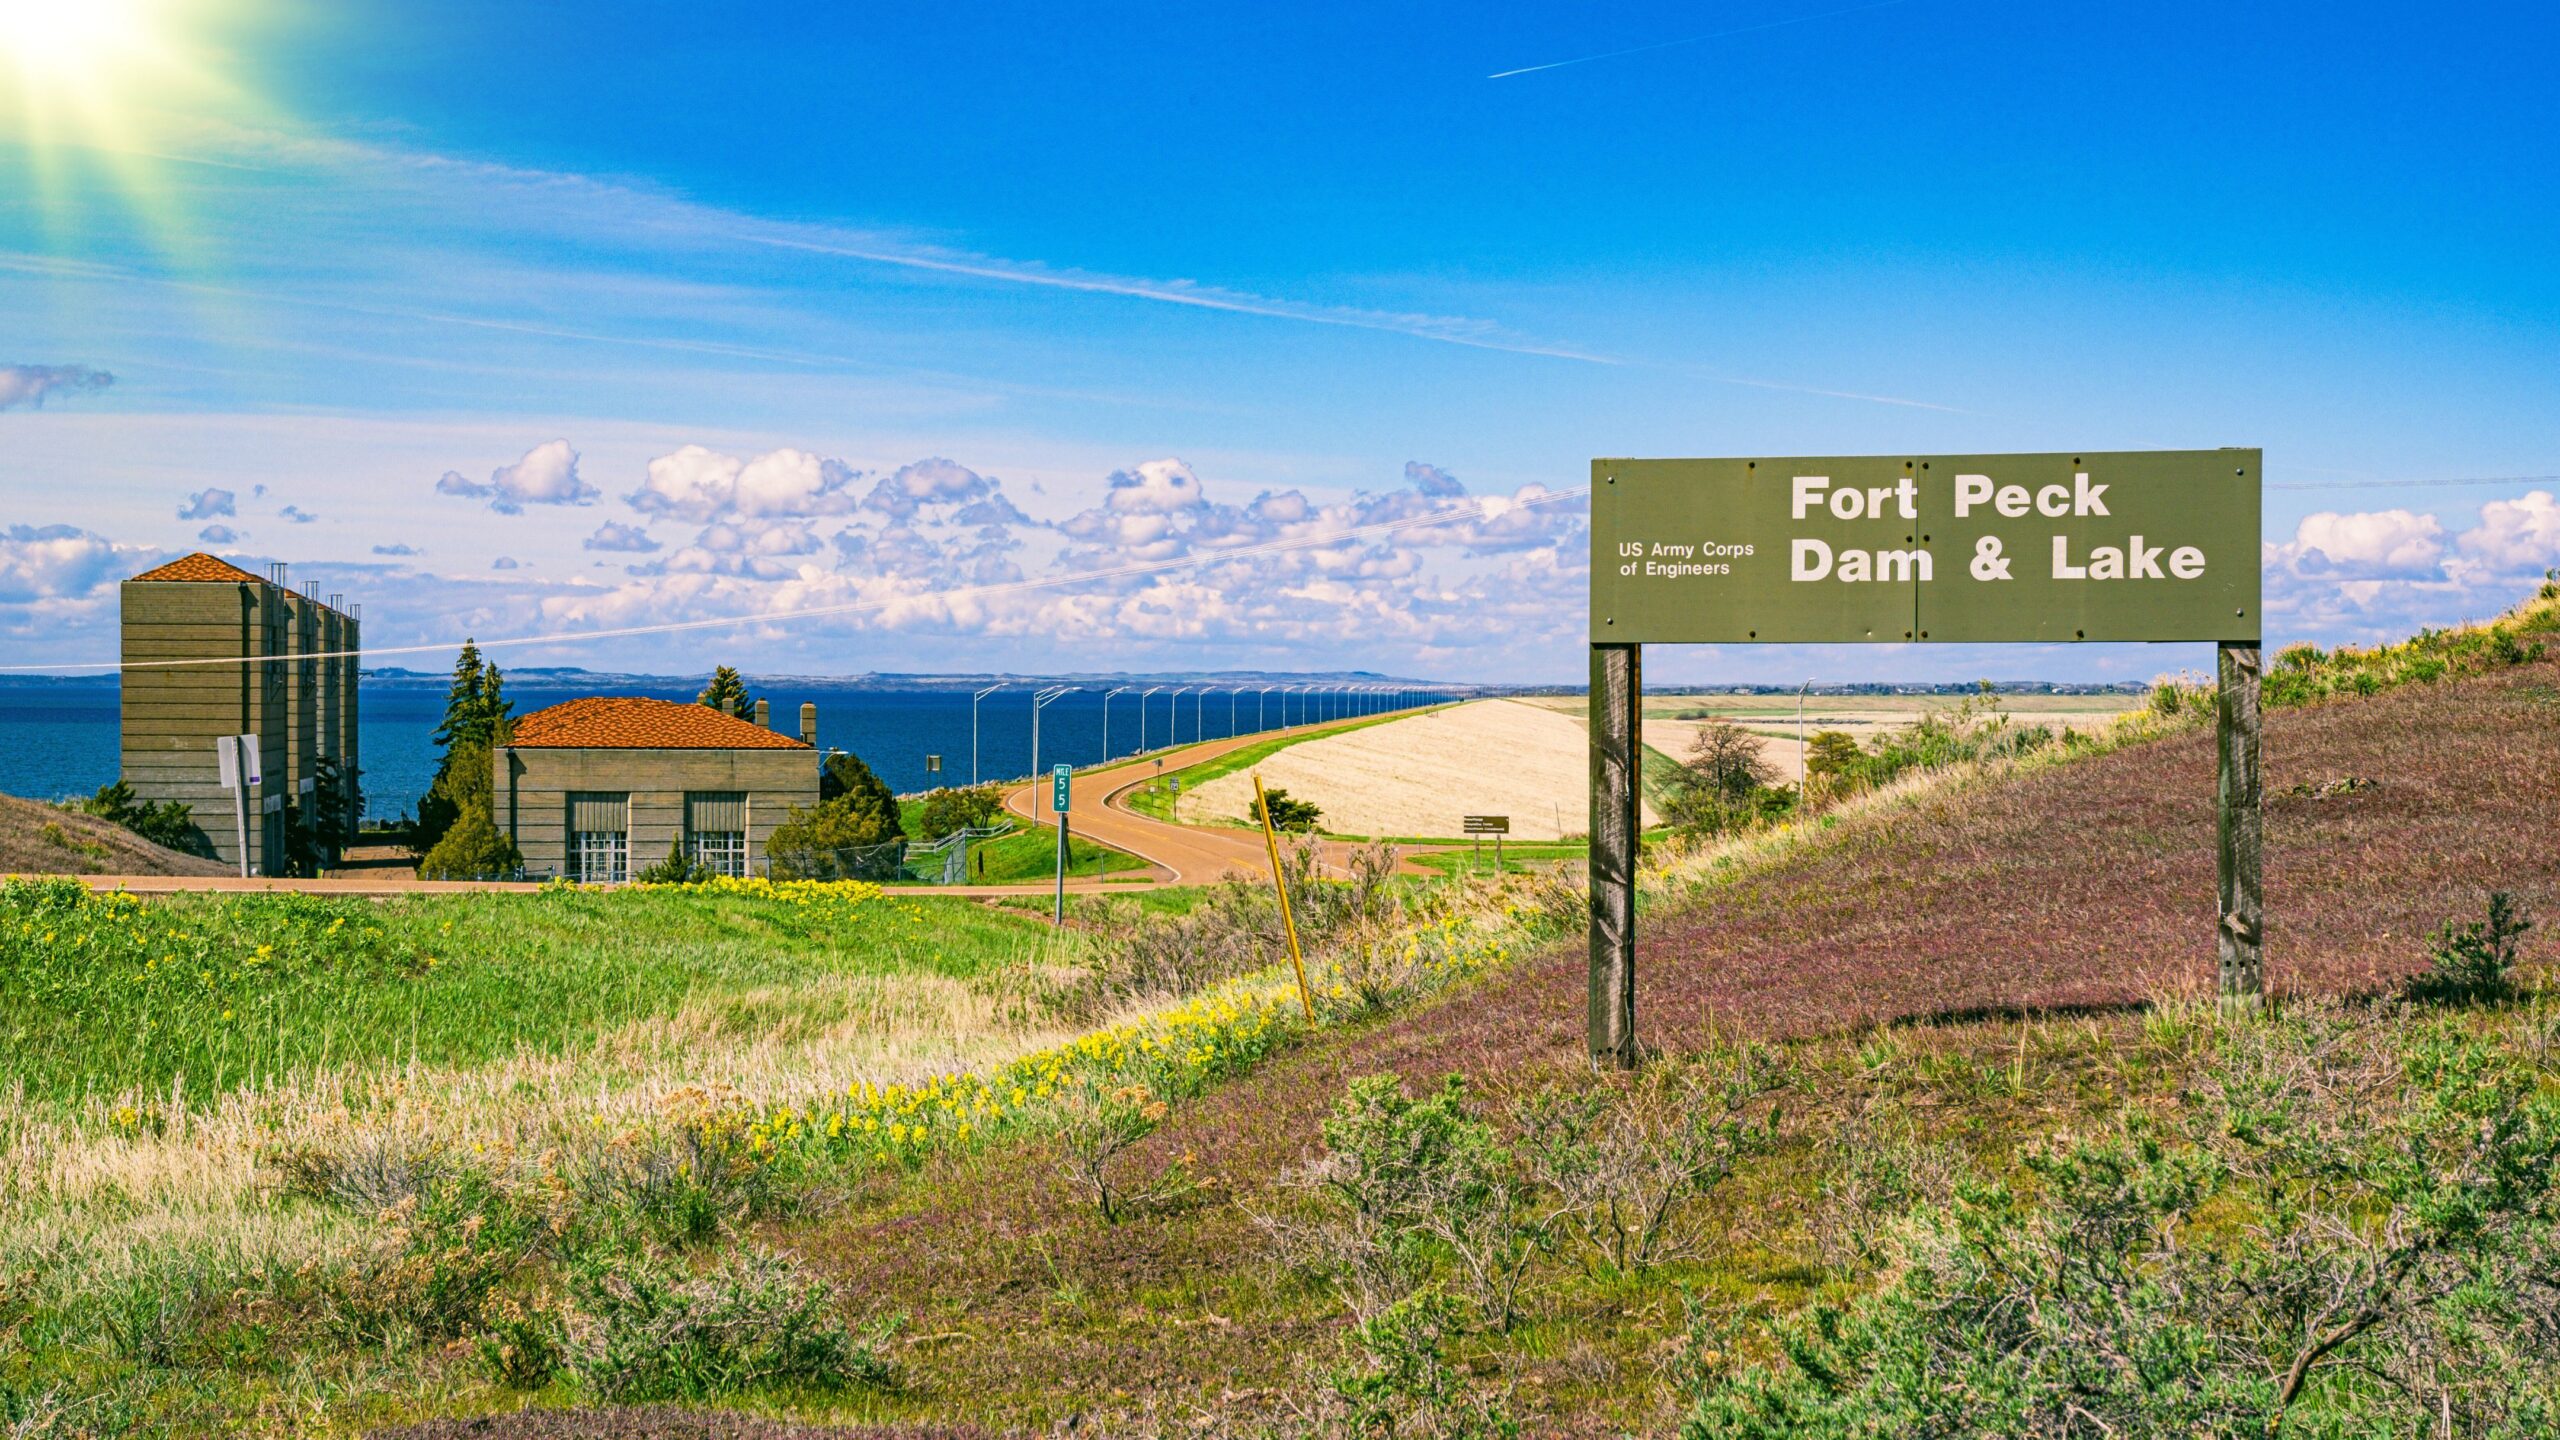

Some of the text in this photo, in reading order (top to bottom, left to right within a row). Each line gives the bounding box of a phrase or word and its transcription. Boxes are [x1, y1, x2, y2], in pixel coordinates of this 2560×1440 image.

[1792, 473, 2111, 520] Fort Peck
[1619, 541, 1755, 559] US Army Corps
[1791, 535, 2206, 582] Dam & Lake
[1620, 560, 1730, 579] of Engineers
[1055, 767, 1069, 776] MILE
